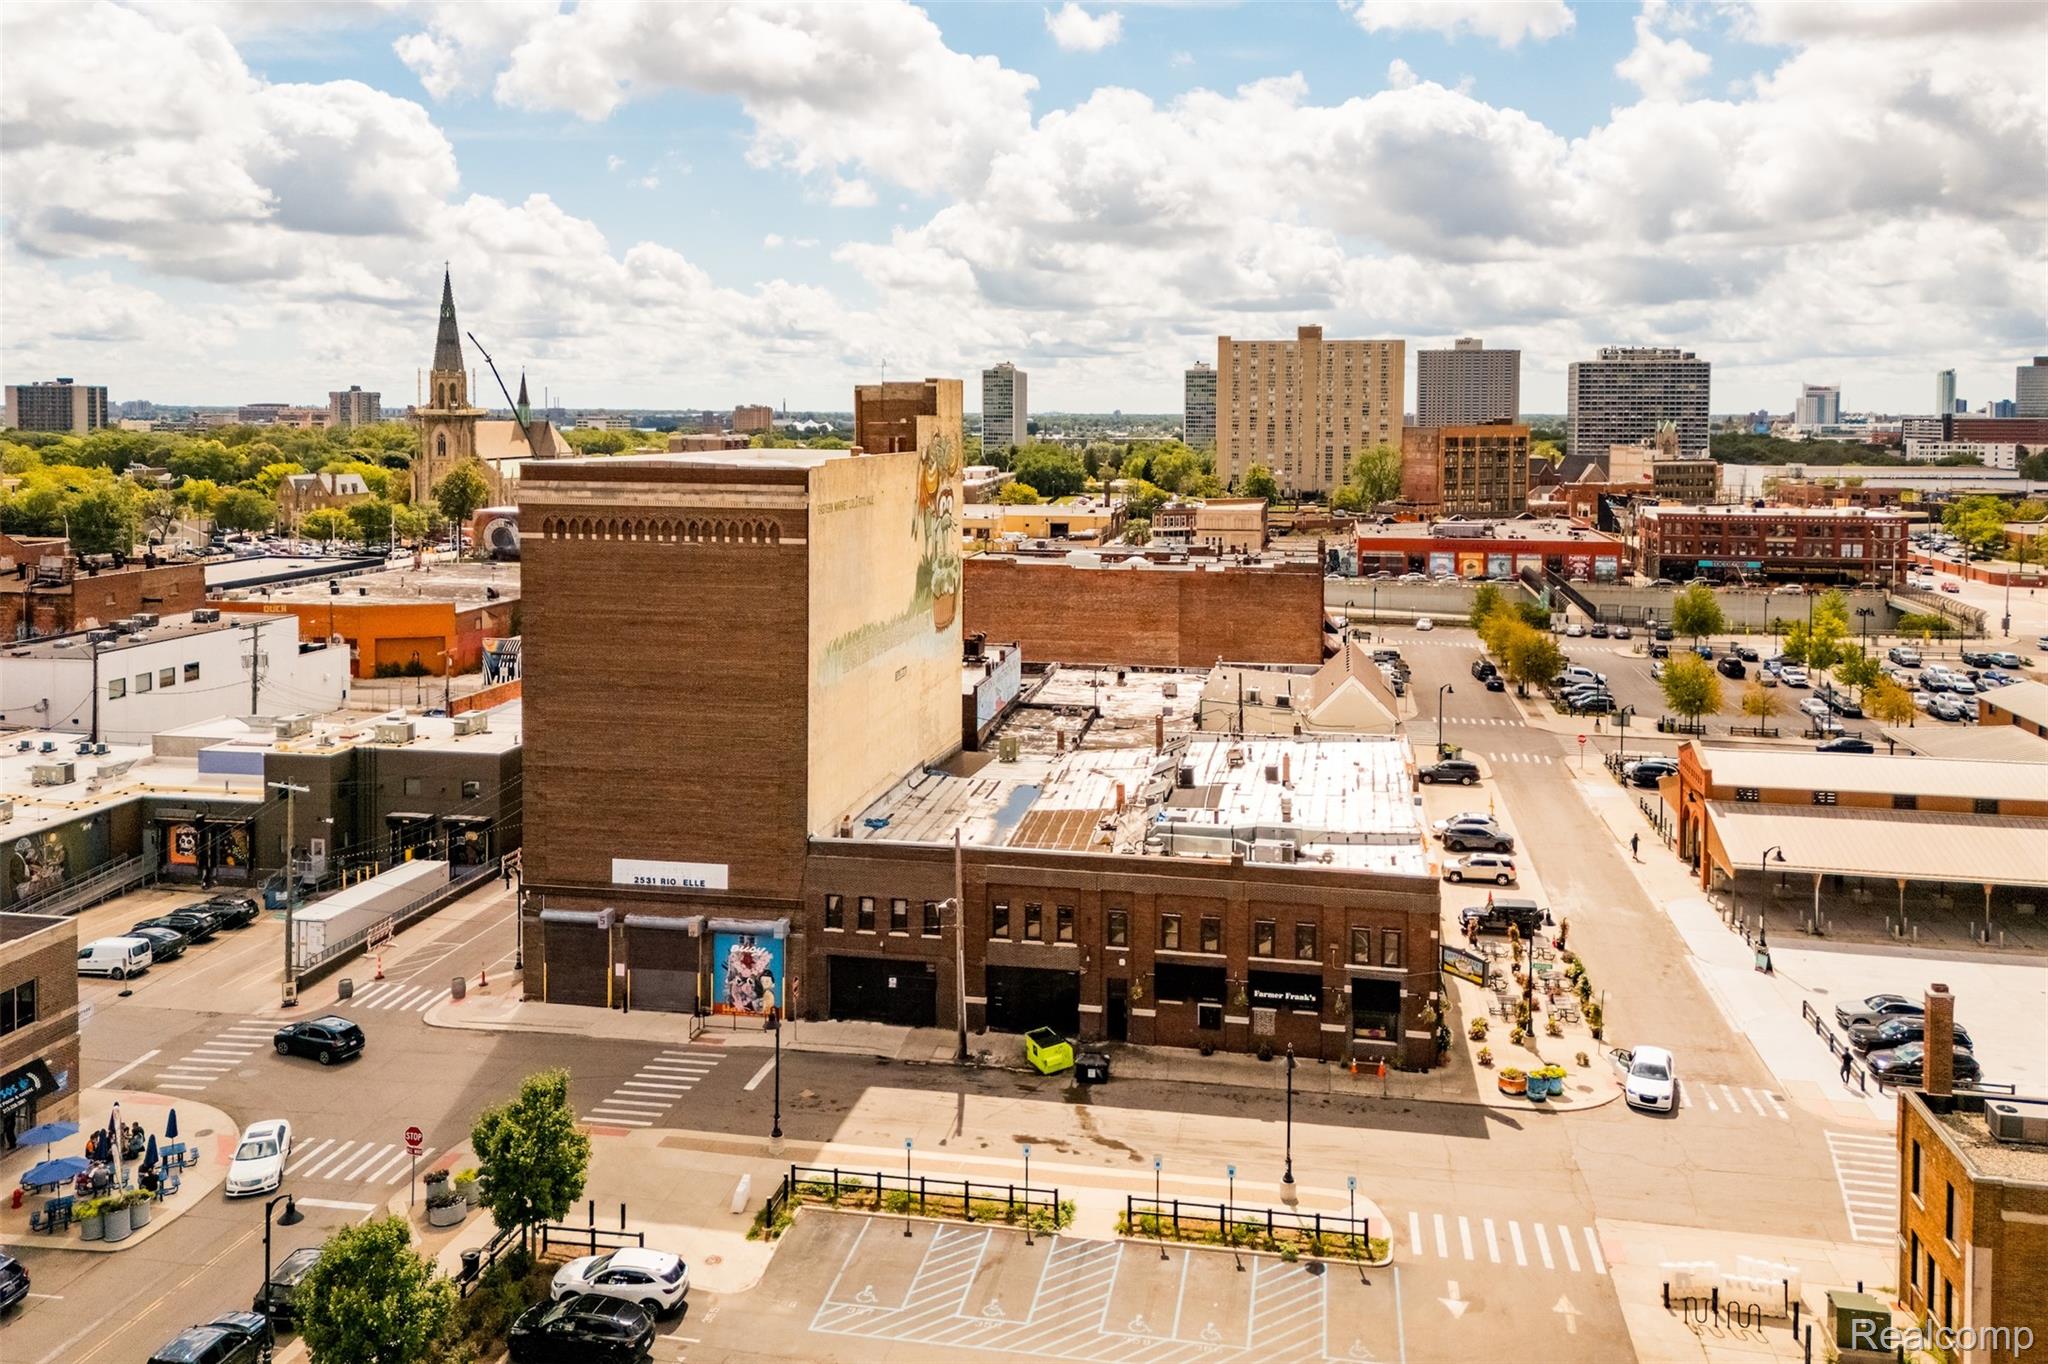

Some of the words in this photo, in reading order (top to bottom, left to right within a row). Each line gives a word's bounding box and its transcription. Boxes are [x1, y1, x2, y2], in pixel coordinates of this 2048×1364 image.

[634, 876, 656, 885] 2531
[1253, 989, 1284, 999] Farmer
[1285, 991, 1317, 1002] Frank's
[405, 1132, 422, 1142] STOP
